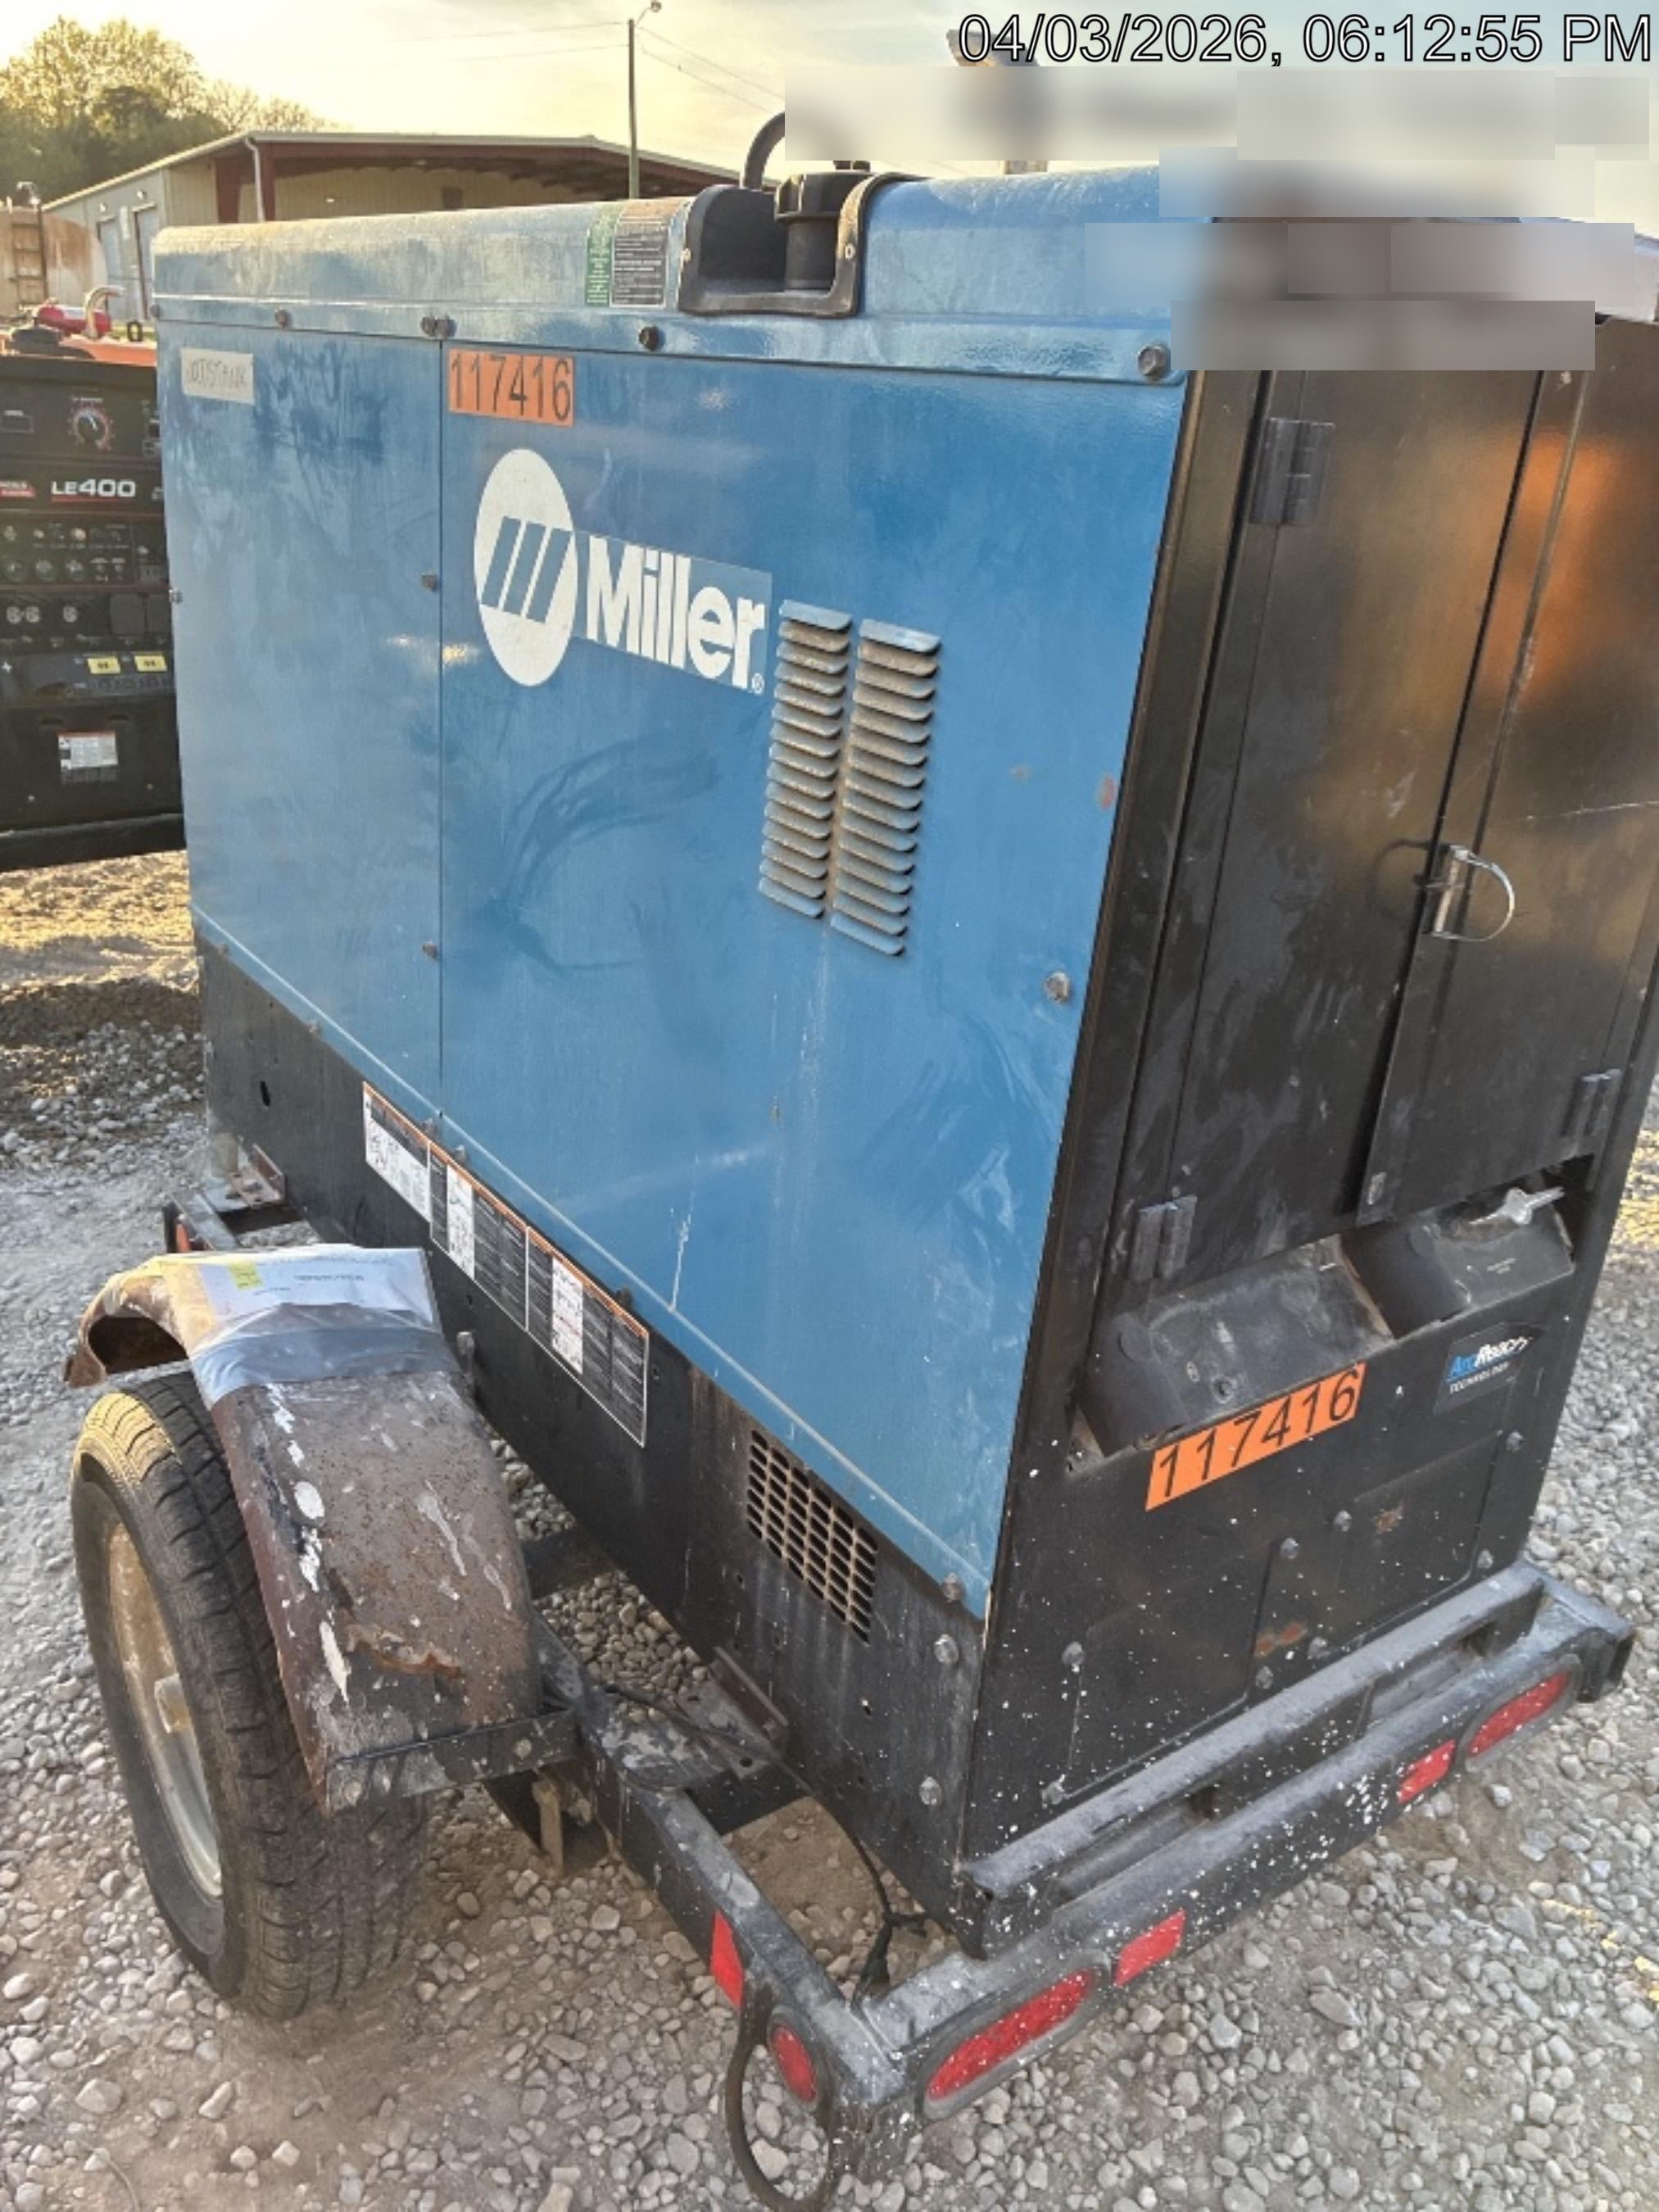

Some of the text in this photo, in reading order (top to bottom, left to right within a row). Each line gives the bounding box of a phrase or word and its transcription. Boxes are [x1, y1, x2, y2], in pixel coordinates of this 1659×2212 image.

[451, 353, 571, 421] 117416
[51, 478, 136, 497] LE400
[586, 535, 765, 689] Miller
[1159, 1369, 1358, 1498] 117416
